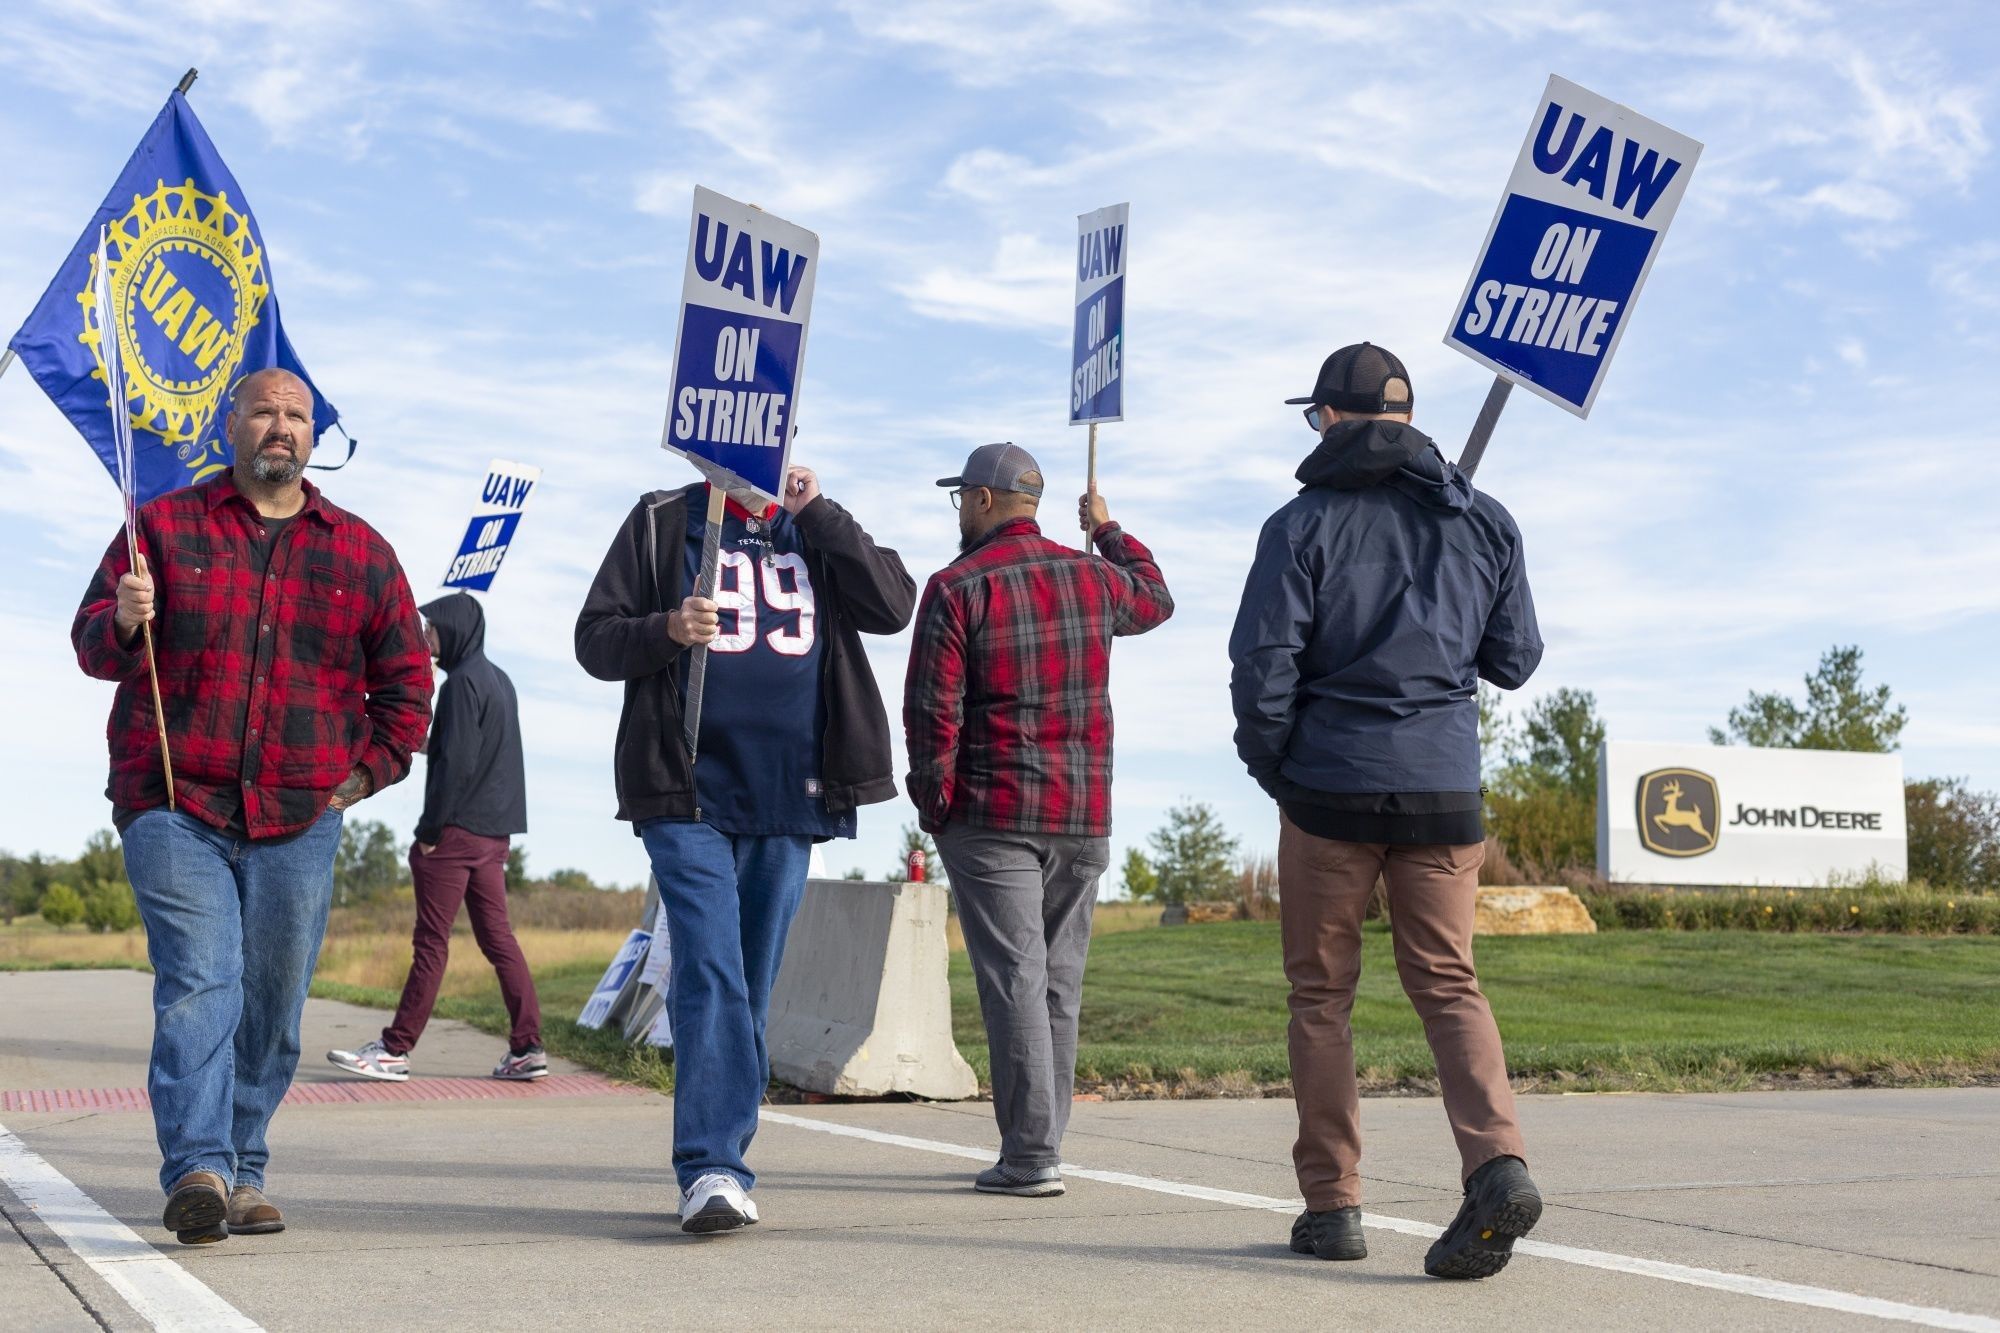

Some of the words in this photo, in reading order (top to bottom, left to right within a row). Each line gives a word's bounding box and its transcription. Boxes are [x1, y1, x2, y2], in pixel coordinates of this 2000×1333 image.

[1532, 102, 1682, 221] UAW
[116, 253, 139, 318] AUTOMOBILE
[140, 225, 179, 252] AEROSPACE
[182, 226, 201, 238] AND
[204, 233, 249, 292] AGRICULURAL
[694, 213, 808, 316] UAW
[1079, 224, 1124, 282] UAW
[1530, 222, 1602, 285] ON
[140, 258, 232, 371] UAW
[1087, 296, 1106, 350] ON
[1464, 279, 1619, 357] STRIKE
[714, 326, 760, 382] ON
[1074, 334, 1120, 413] STRIKE
[676, 386, 786, 448] STRIKE
[482, 472, 534, 509] UAW
[446, 544, 508, 583] STRIKE
[476, 518, 505, 550] ON
[707, 548, 815, 656] 99
[1729, 803, 1796, 828] JOHN
[1800, 806, 1882, 830] DEERE
